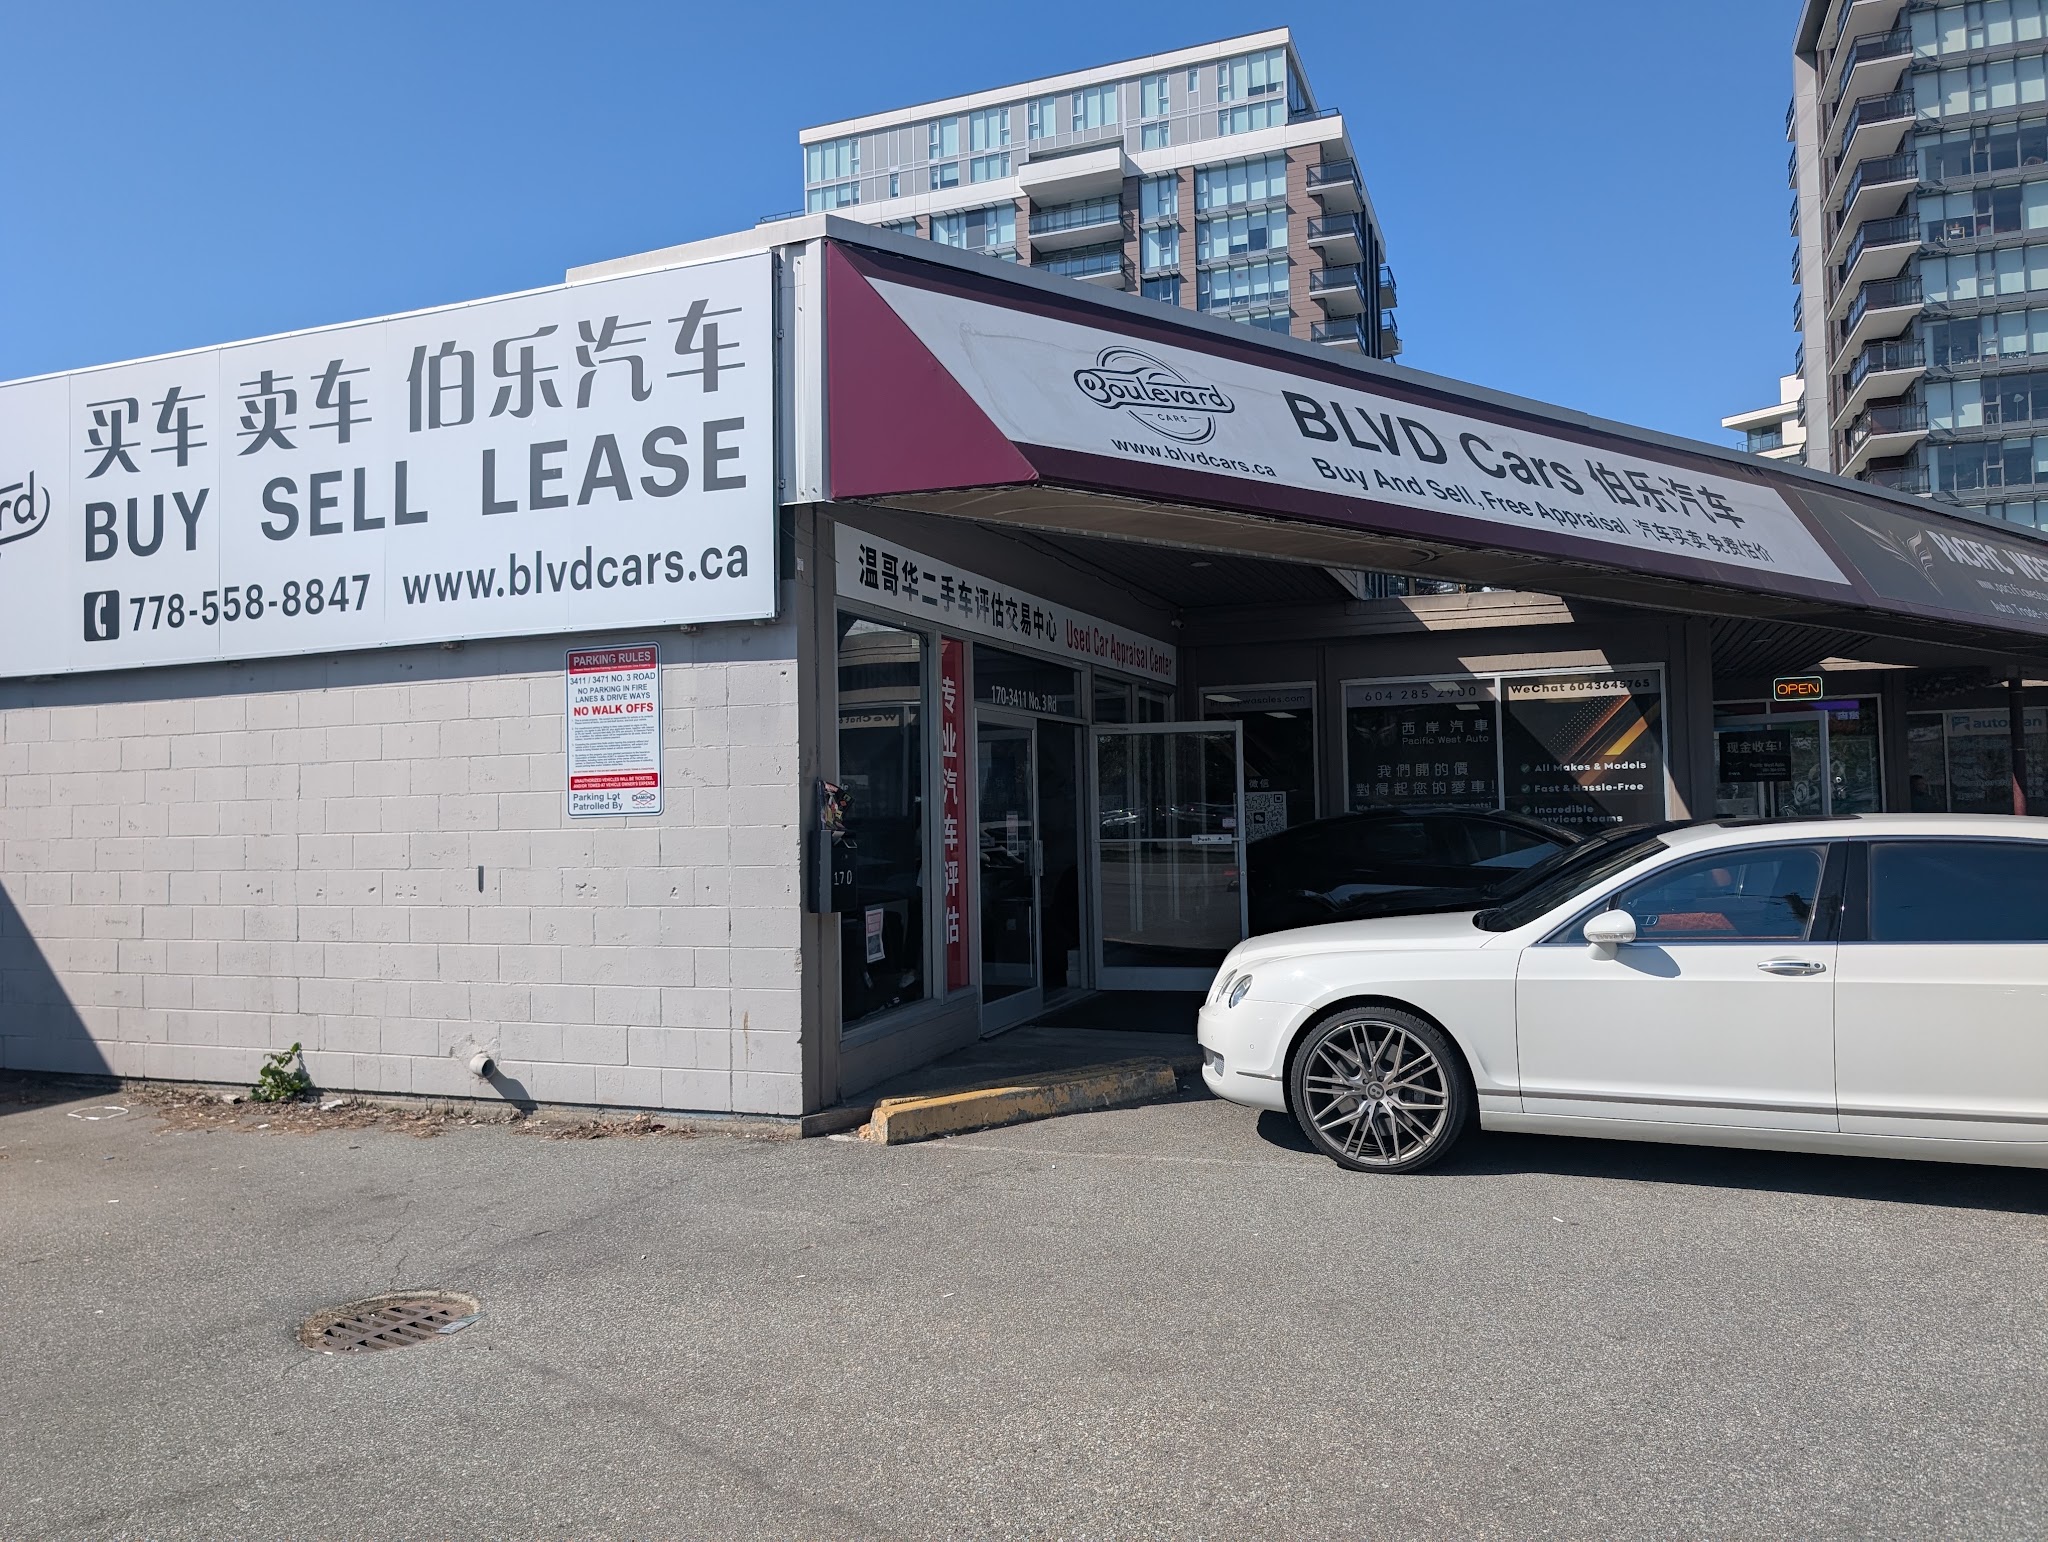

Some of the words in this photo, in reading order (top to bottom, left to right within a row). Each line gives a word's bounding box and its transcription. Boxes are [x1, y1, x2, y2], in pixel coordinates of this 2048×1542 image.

[84, 385, 208, 479] 买车
[236, 358, 373, 457] 卖车
[407, 298, 746, 433] 伯乐汽车
[1083, 371, 1229, 408] Boulevard
[1157, 413, 1188, 424] CARS
[1110, 438, 1278, 478] www.blvdcars.ca
[1281, 389, 1448, 466] BLVD
[1459, 432, 1585, 496] Cars
[1584, 458, 1746, 529] 伯乐汽车
[85, 487, 210, 562] BUY
[261, 460, 428, 541] SELL
[482, 416, 747, 516] LEASE
[1311, 457, 1369, 491] Buy
[1373, 468, 1427, 497] And
[1480, 490, 1534, 517] Free
[1534, 501, 1632, 535] Appraisal
[1632, 518, 1711, 551] 汽车买卖
[1706, 532, 1776, 564] 免费估价
[1926, 529, 2015, 575] PACIFIC
[129, 573, 371, 633] 778-558-8847
[403, 543, 748, 605] www.blvdcars.ca
[858, 543, 1057, 643] 温哥华二手车评估交易中心
[1066, 618, 1091, 653] Used
[1094, 627, 1109, 658] Car
[1111, 633, 1148, 669] Appraisal
[1150, 646, 1172, 676] Center
[573, 653, 616, 667] PARKING
[618, 651, 651, 663] RULES
[570, 676, 586, 686] 3411
[592, 675, 609, 684] 3471
[611, 674, 625, 682] NO.
[626, 673, 631, 681] 3
[633, 672, 656, 681] ROAD
[1510, 683, 1566, 694] WeChat
[1569, 678, 1650, 692] 6043645765
[577, 687, 589, 695] NO
[589, 685, 621, 694] PARKING
[623, 684, 630, 692] IN
[631, 683, 648, 691] FIRE
[1364, 691, 1393, 702] 604
[1401, 689, 1429, 700] 285
[1777, 682, 1819, 695] OPEN
[575, 695, 598, 703] LANES
[600, 694, 605, 702] &
[606, 693, 628, 701] DRIVE
[629, 691, 651, 700] WAYS
[991, 685, 1027, 709] 170-3411
[1029, 691, 1041, 711] No.
[1041, 695, 1047, 712] 3
[1048, 695, 1057, 713] Rd
[573, 706, 589, 716] NO
[592, 704, 623, 715] WALK
[626, 702, 654, 713] OFFS
[1401, 718, 1489, 736] 西岸汽車
[1973, 718, 2042, 729] autoan
[1402, 736, 1435, 745] Pacific
[1438, 735, 1462, 744] West
[1466, 734, 1489, 743] Auto
[1377, 761, 1469, 778] 我們開的價
[1534, 763, 1550, 772] All
[1553, 762, 1591, 772] Makes
[1593, 762, 1602, 770] &
[1604, 760, 1647, 770] Models
[1534, 784, 1560, 793] Fast
[1563, 783, 1571, 792] &
[1572, 782, 1645, 792] Hassle-Free
[573, 792, 605, 802] Parking
[607, 792, 621, 800] Lot
[573, 801, 610, 811] Patrolled
[612, 801, 624, 811] By
[941, 675, 960, 945] 专业汽车评估
[1534, 805, 1594, 814] Incredible
[1540, 814, 1583, 824] ervices
[1586, 814, 1624, 823] teams
[833, 870, 853, 886] 170
